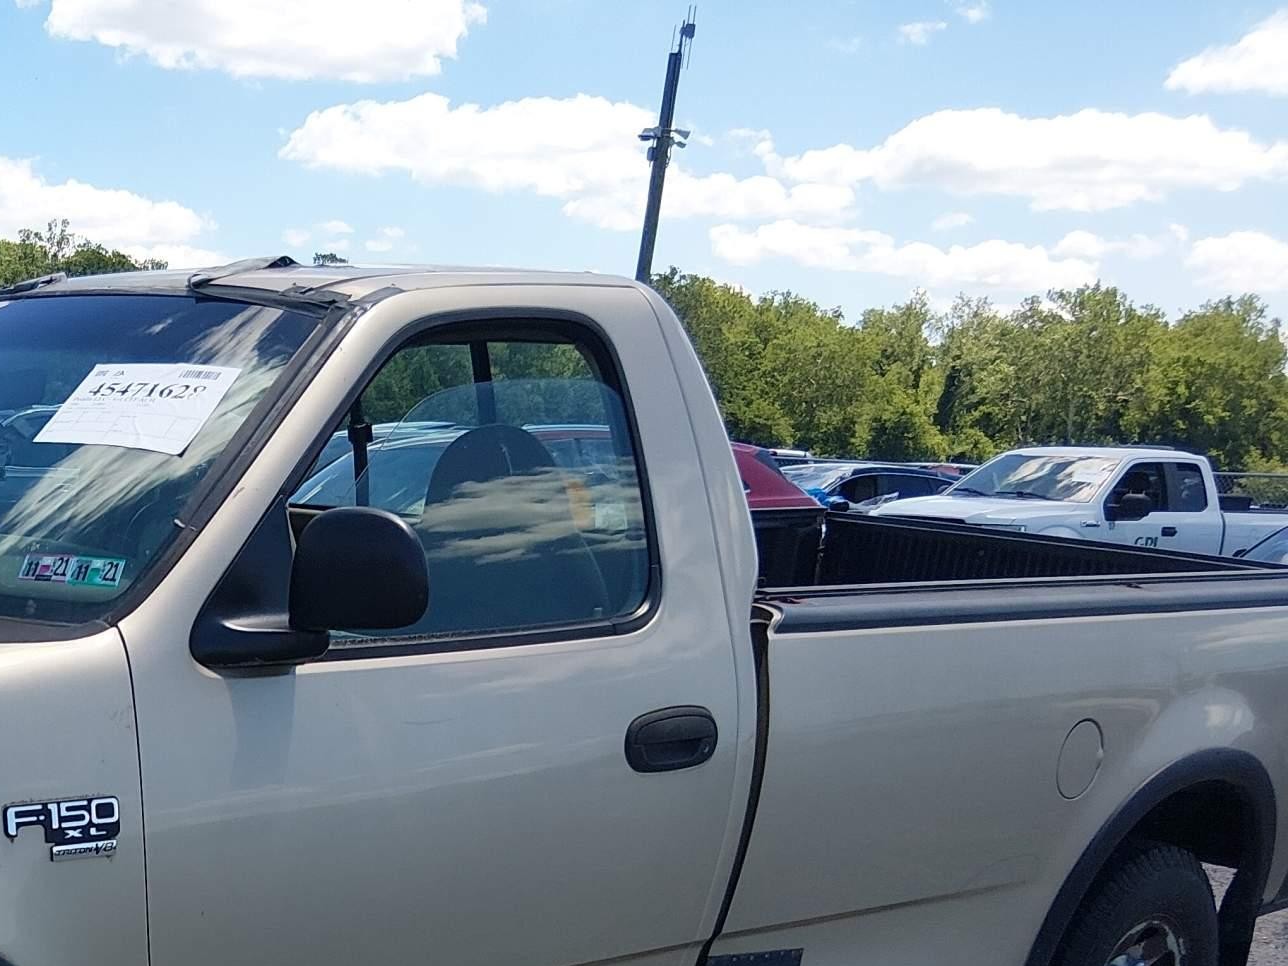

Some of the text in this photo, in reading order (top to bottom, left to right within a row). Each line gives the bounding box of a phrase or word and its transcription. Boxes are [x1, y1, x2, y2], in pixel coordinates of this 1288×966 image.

[88, 382, 207, 400] 45471628
[54, 557, 70, 576] 21
[103, 561, 119, 582] 21
[6, 797, 120, 836] F-150
[64, 827, 107, 839] XL
